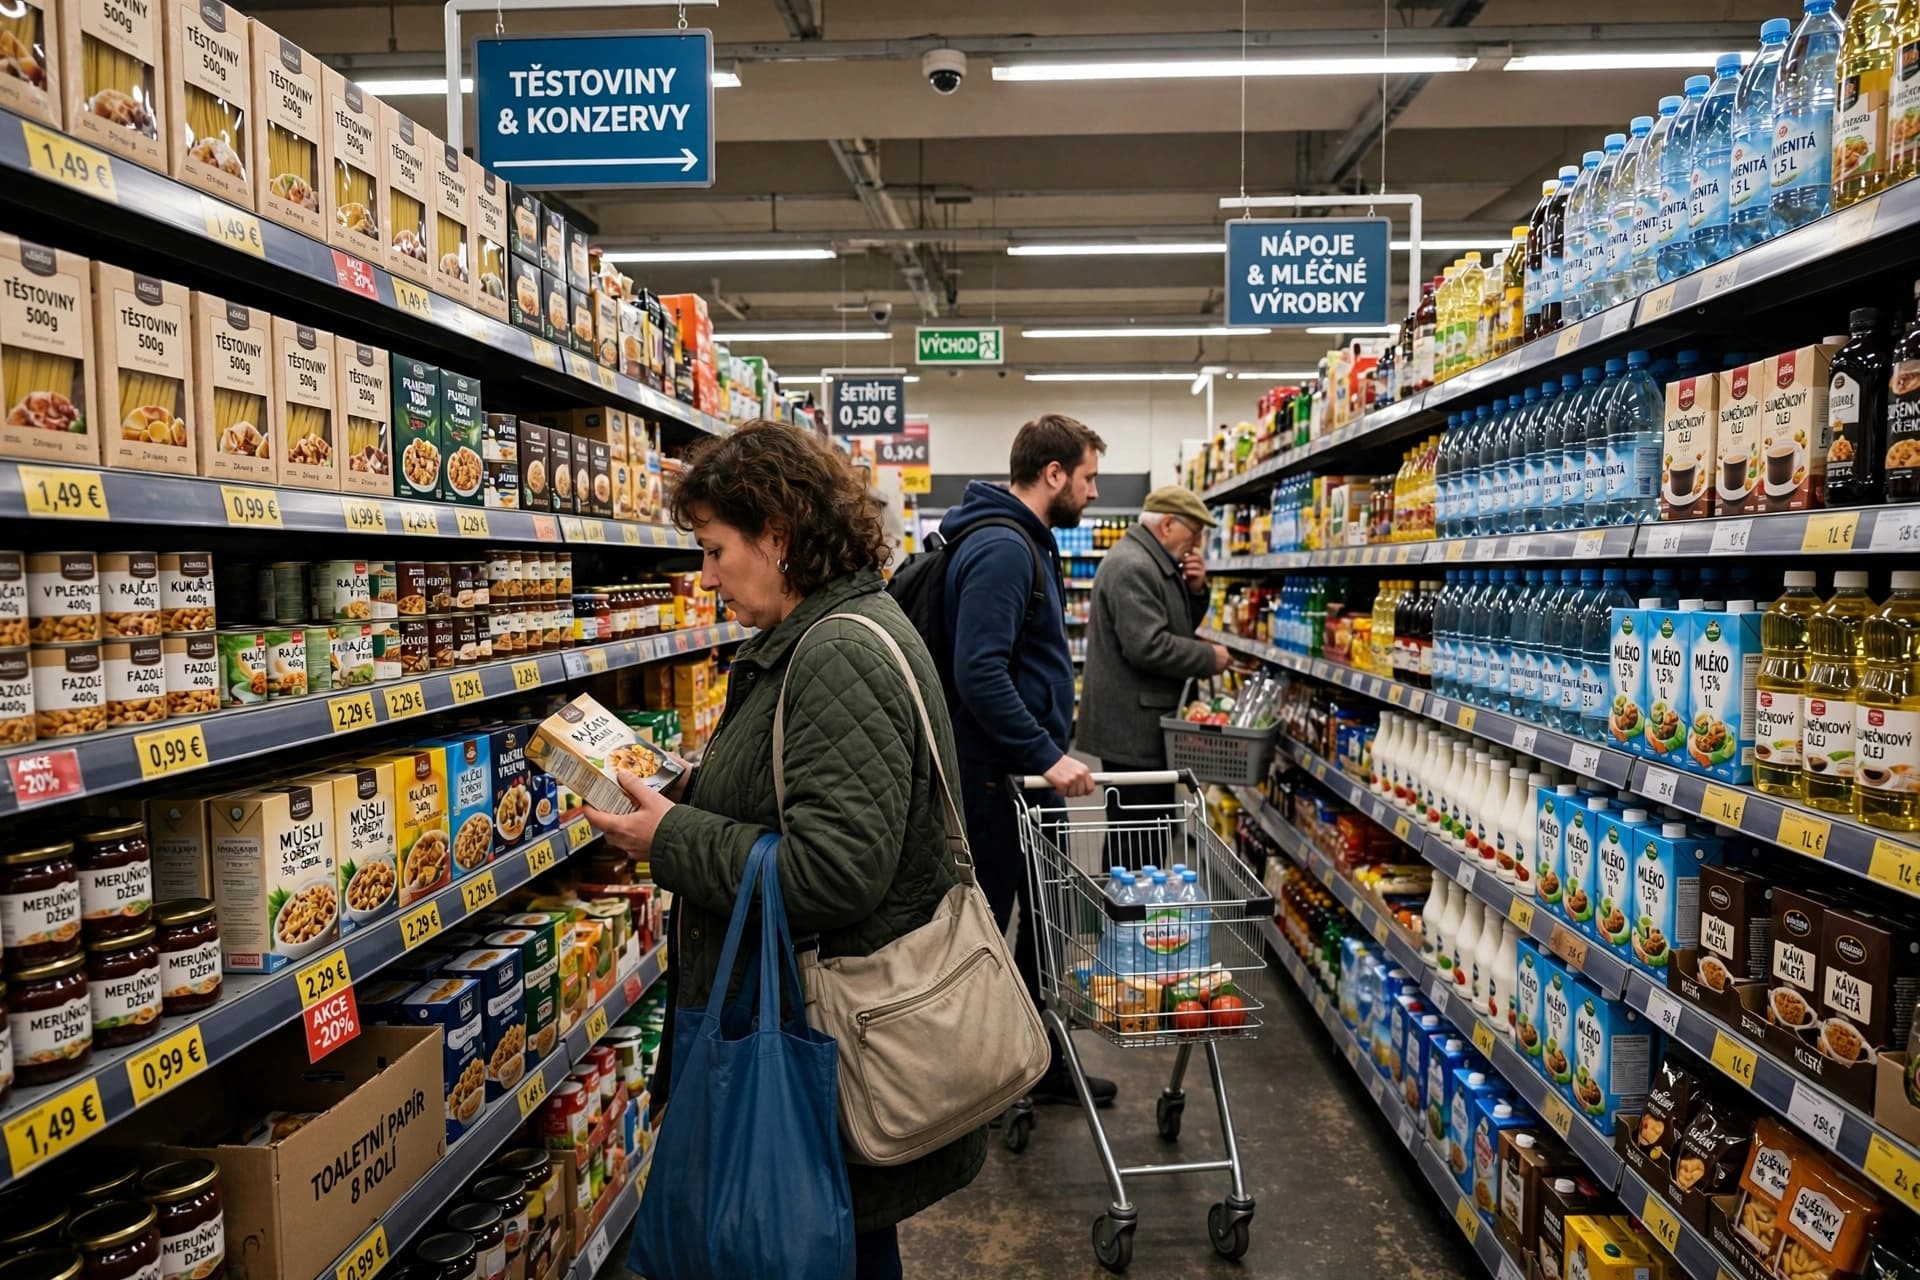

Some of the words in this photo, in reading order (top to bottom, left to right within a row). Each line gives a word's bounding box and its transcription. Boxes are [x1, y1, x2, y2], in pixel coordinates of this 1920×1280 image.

[104, 2, 132, 33] 500g
[187, 26, 239, 68] TĚSTOVINY
[202, 54, 227, 81] 500g
[269, 69, 313, 105] TĚSTOVINY
[509, 64, 676, 97] TĚSTOVINY
[282, 95, 302, 119] 500g
[335, 110, 373, 141] TĚSTOVINY
[497, 110, 519, 135] &
[528, 104, 691, 134] KONZERVY
[347, 133, 364, 155] 500g
[42, 143, 87, 174] 1,49
[96, 165, 110, 189] €
[392, 143, 423, 171] TĚSTOVINY
[1789, 158, 1797, 170] L
[215, 212, 243, 241] 1,49
[249, 230, 260, 248] €
[1261, 230, 1355, 256] NÁPOJE
[1247, 265, 1264, 285] &
[1271, 257, 1367, 285] MLÉČNÉ
[3, 276, 75, 313] TĚSTOVINY
[1250, 288, 1366, 314] VÝROBKY
[27, 307, 58, 332] 500g
[120, 306, 178, 337] TĚSTOVINY
[139, 334, 164, 356] 500g
[215, 332, 261, 359] TĚSTOVINY
[921, 330, 978, 354] VÝCHOD
[229, 355, 251, 376] 500g
[287, 351, 327, 376] TĚSTOVINY
[299, 373, 318, 391] 500g
[349, 368, 383, 391] TĚSTOVINY
[359, 388, 375, 405] 500g
[840, 405, 880, 428] 0,50
[884, 405, 896, 425] €
[1731, 422, 1744, 434] OLEJ
[1775, 412, 1791, 425] OLEJ
[1678, 431, 1691, 443] OLEJ
[38, 480, 81, 512] 1,49
[88, 484, 102, 508] €
[234, 496, 264, 522] 0,99
[268, 499, 278, 519] €
[351, 508, 373, 528] 0,99
[376, 510, 383, 526] €
[1843, 525, 1853, 543] €
[1614, 643, 1640, 663] MLÉKO
[1651, 646, 1681, 668] MLÉKO
[1695, 650, 1729, 673] MLÉKO
[127, 668, 163, 682] FAZOLE
[184, 661, 217, 675] FAZOLE
[1618, 663, 1633, 679] 1,5%
[1656, 667, 1673, 684] 1,5%
[62, 675, 102, 690] FAZOLE
[1621, 680, 1628, 693] 1L
[1660, 686, 1667, 700] 1L
[1700, 674, 1720, 693] 1,5%
[391, 694, 413, 715] 2,29
[415, 692, 422, 708] €
[1705, 694, 1713, 708] 1L
[338, 702, 362, 728] 2,29
[365, 701, 373, 719] €
[1808, 732, 1826, 747] OLEJ
[1863, 743, 1884, 759] OLEJ
[150, 738, 186, 771] 0,99
[191, 736, 202, 757] €
[19, 770, 60, 794] -20%
[1723, 802, 1732, 819] 1L
[1733, 805, 1741, 821] €
[1540, 820, 1559, 839] MLÉKO
[1802, 831, 1812, 849] 1L
[1816, 834, 1823, 850] €
[1567, 832, 1589, 854] MLÉKO
[1570, 851, 1583, 866] 1,5%
[1601, 850, 1625, 871] MLÉKO
[1605, 868, 1619, 884] 1,5%
[1638, 865, 1665, 889] MLÉKO
[117, 883, 145, 900] DŽEM
[468, 884, 488, 907] 2,29
[488, 878, 495, 895] €
[1642, 887, 1658, 903] 1,5%
[46, 904, 75, 925] DŽEM
[1646, 904, 1653, 917] 1L
[407, 920, 430, 942] 2,29
[431, 912, 439, 931] €
[1708, 916, 1726, 936] KÁVA
[1706, 932, 1727, 952] MLETÁ
[1783, 943, 1804, 966] KÁVA
[189, 961, 216, 980] DŽEM
[305, 973, 335, 1000] 2,29
[337, 959, 347, 980] €
[1520, 970, 1537, 993] MLÉKO
[1780, 960, 1806, 982] MLETÁ
[1835, 971, 1860, 997] KÁVA
[127, 990, 155, 1009] DŽEM
[313, 994, 349, 1028] AKCE
[1546, 993, 1567, 1017] MLÉKO
[1832, 989, 1861, 1016] MLETÁ
[54, 1021, 84, 1043] DŽEM
[314, 1017, 354, 1049] -20%
[1578, 1017, 1601, 1045] MLÉKO
[143, 1048, 182, 1090] 0,99
[188, 1038, 200, 1063] €
[25, 1104, 76, 1156] 1,49
[82, 1095, 97, 1123] €
[310, 1117, 386, 1202] TOALETNÍ
[388, 1089, 425, 1138] PAPÍR
[351, 1180, 360, 1205] 8
[364, 1142, 397, 1193] ROLÍ
[184, 1242, 215, 1267] DŽEM
[376, 1236, 385, 1259] €
